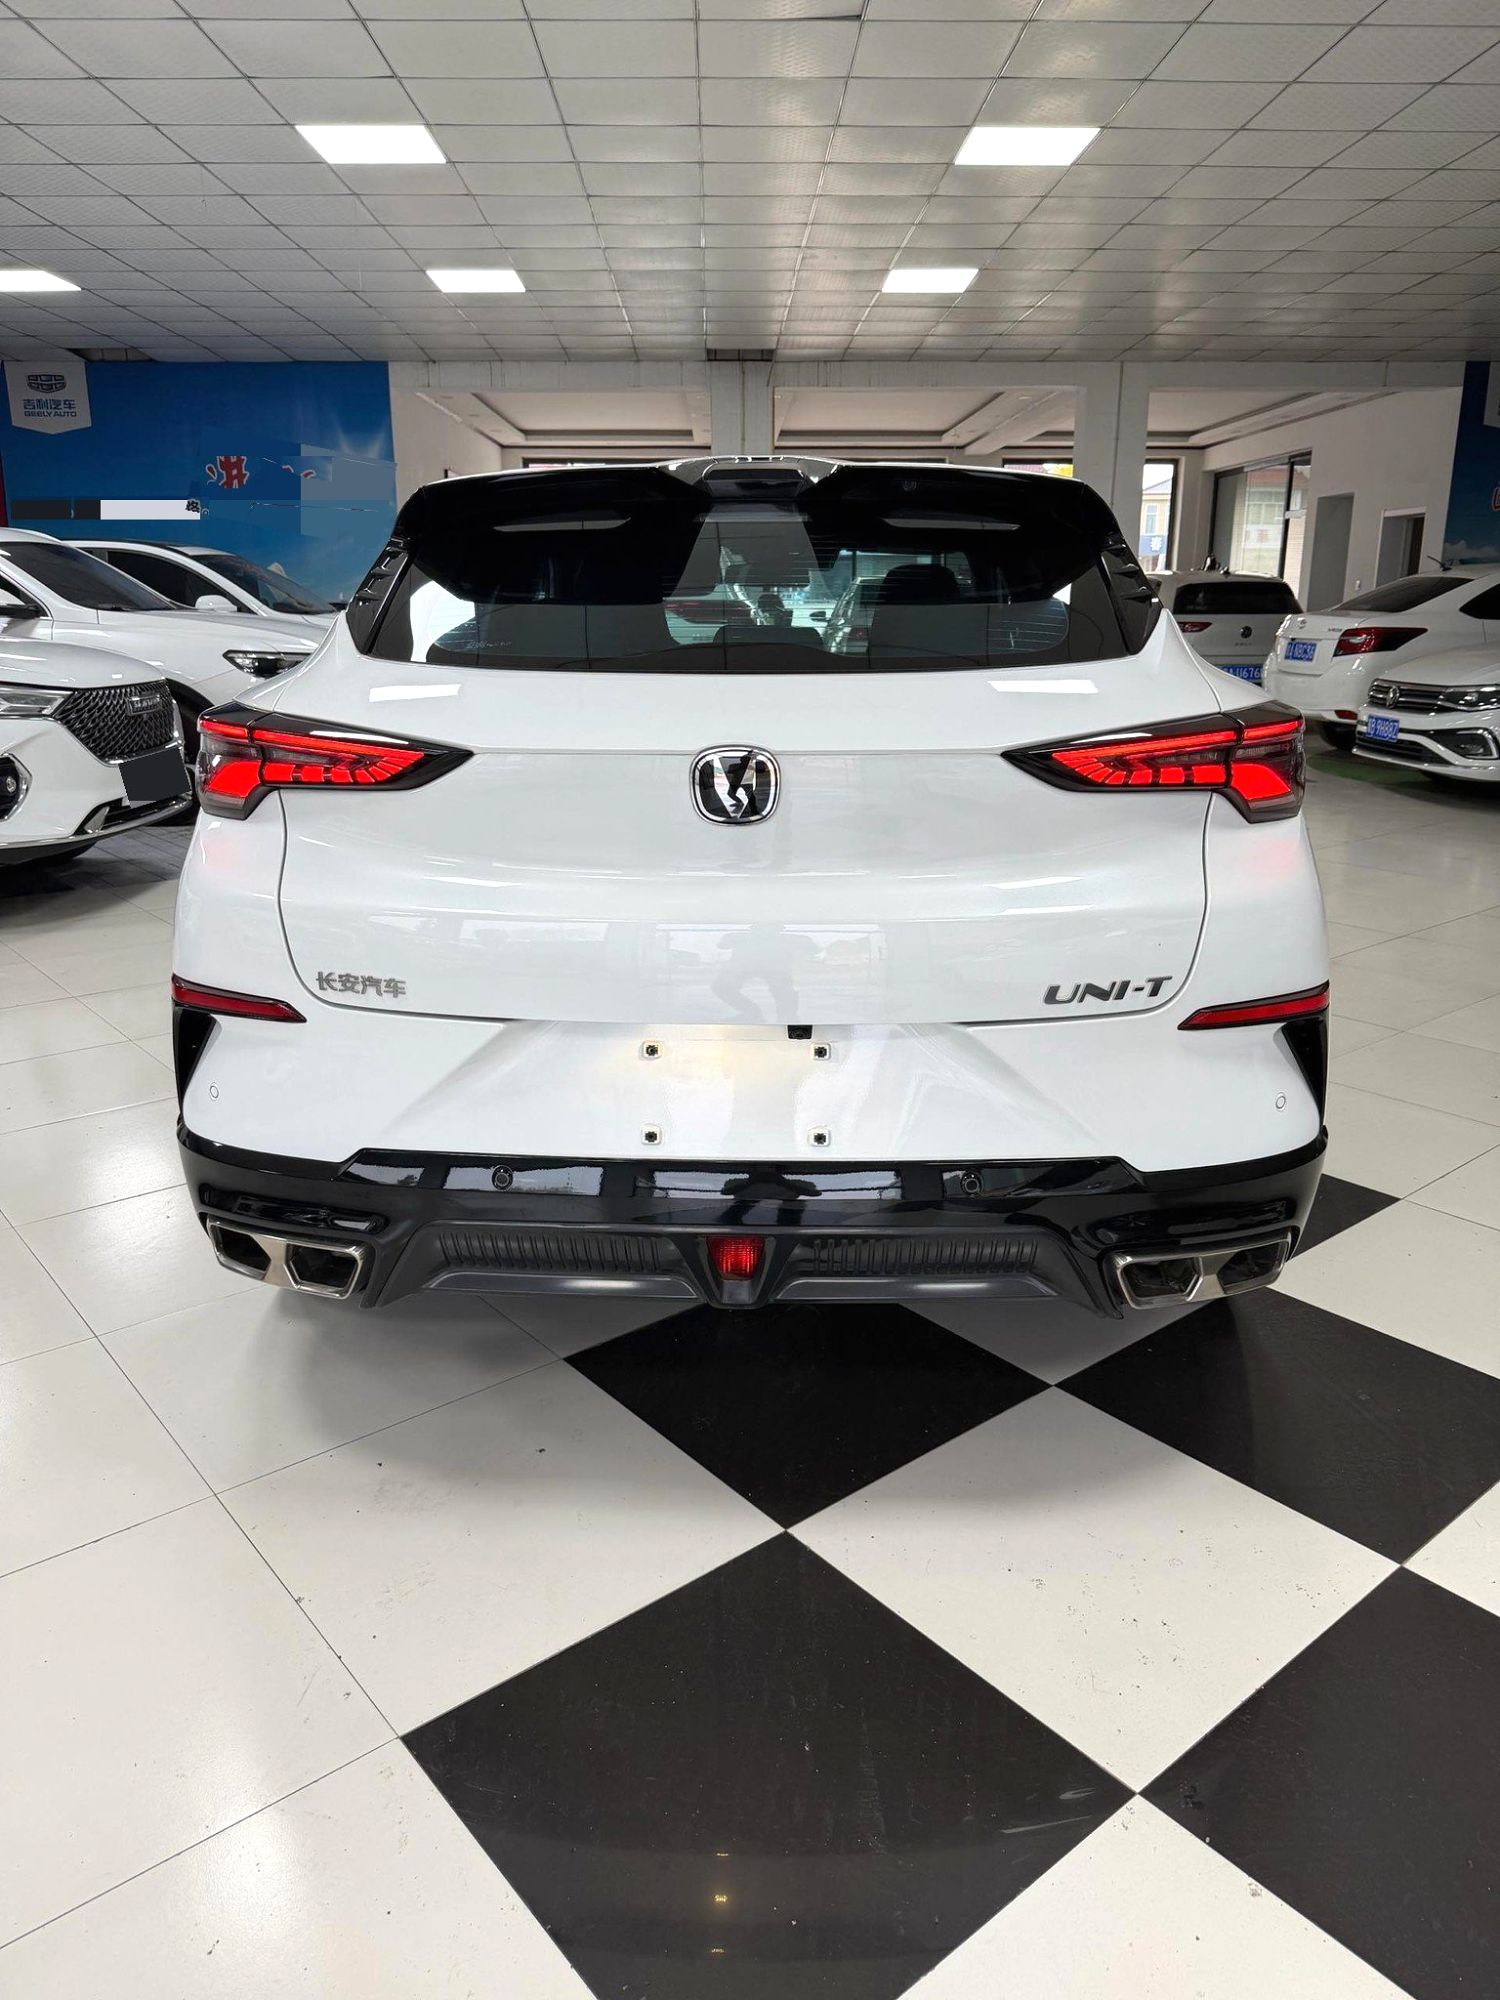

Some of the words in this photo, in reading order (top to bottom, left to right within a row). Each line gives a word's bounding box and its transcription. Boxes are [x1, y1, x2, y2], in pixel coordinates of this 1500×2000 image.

[316, 971, 406, 998] 长安汽车
[1044, 976, 1173, 1005] UNI-T
